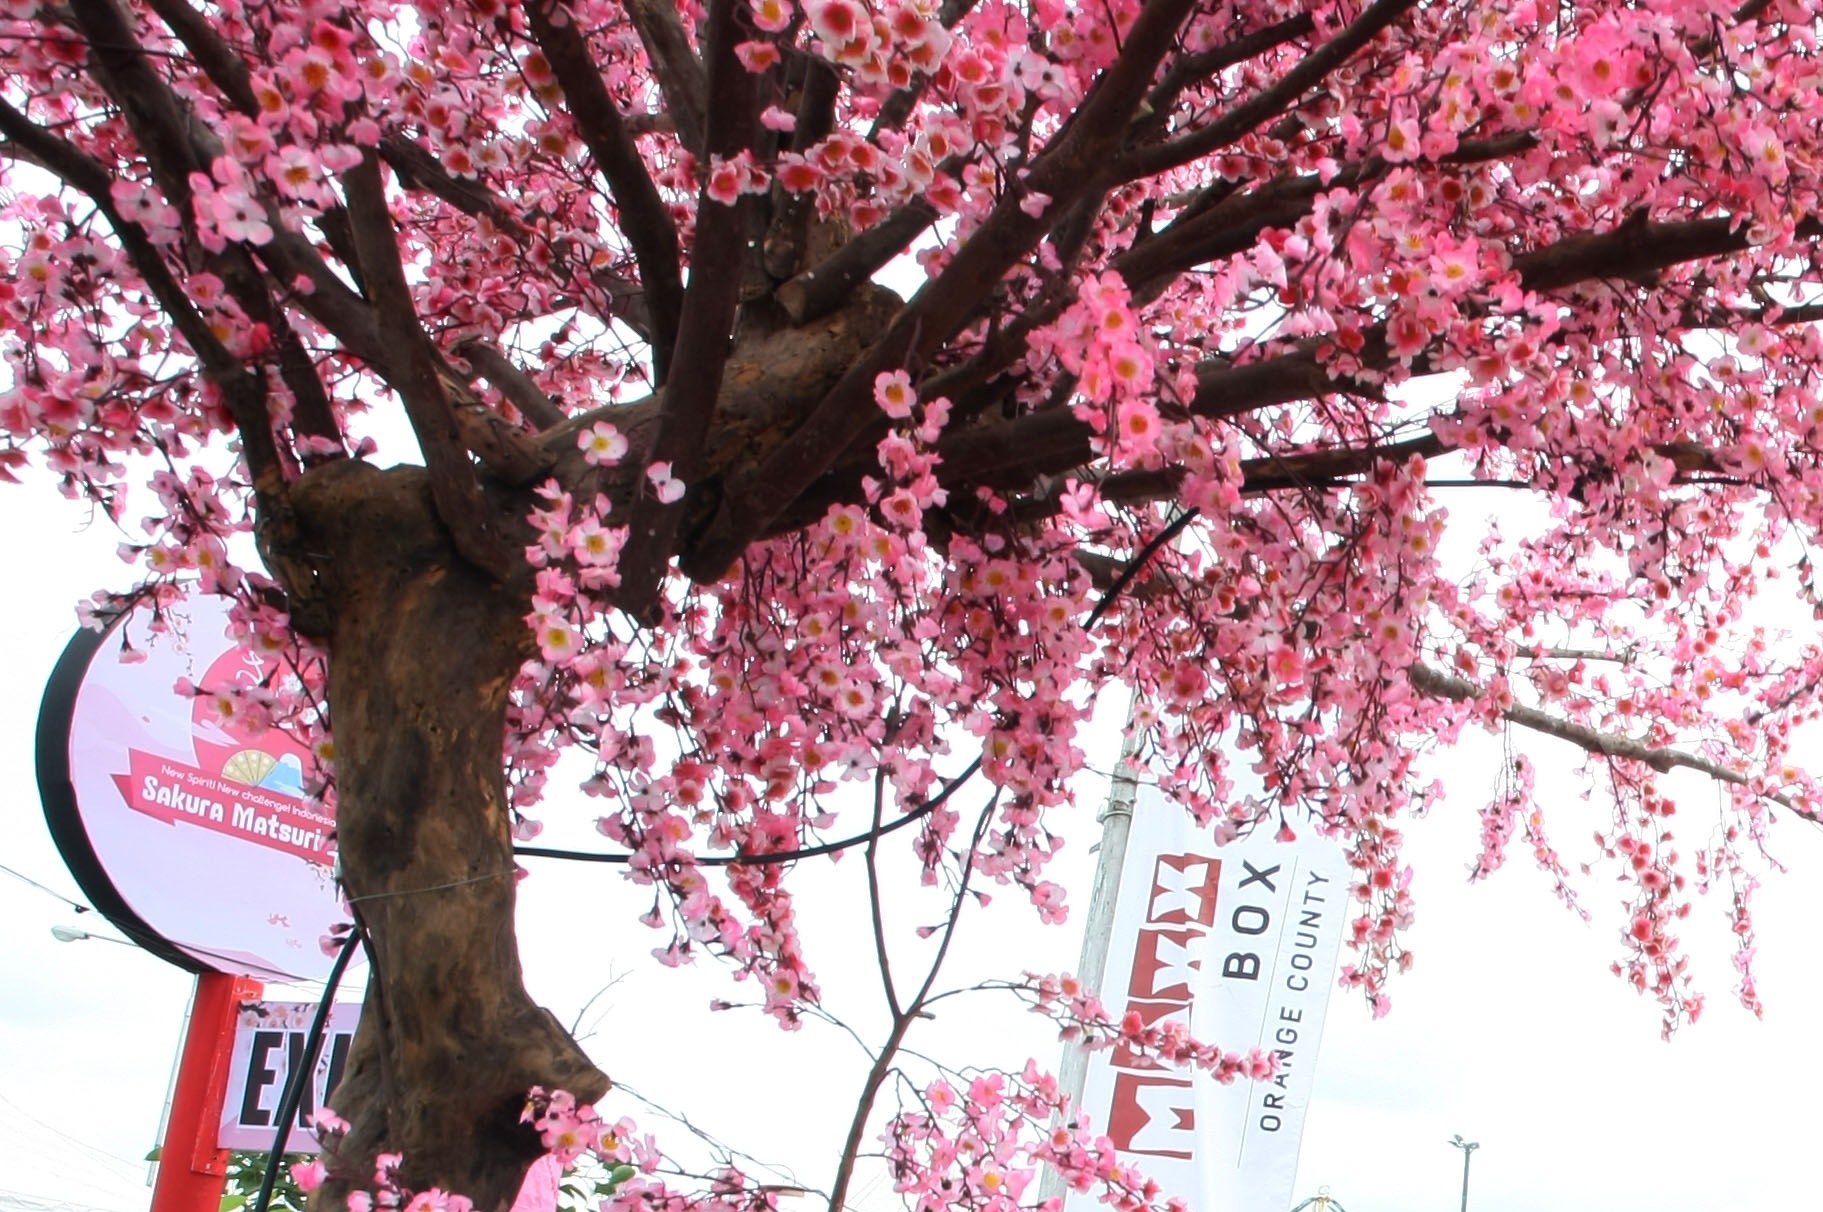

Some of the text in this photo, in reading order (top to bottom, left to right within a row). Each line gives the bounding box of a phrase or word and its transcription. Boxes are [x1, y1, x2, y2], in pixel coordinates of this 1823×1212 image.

[142, 775, 322, 852] Sakura Matsuri
[161, 765, 184, 779] New
[217, 782, 240, 796] New
[1222, 859, 1281, 981] BOX
[1286, 870, 1330, 992] COUNTY
